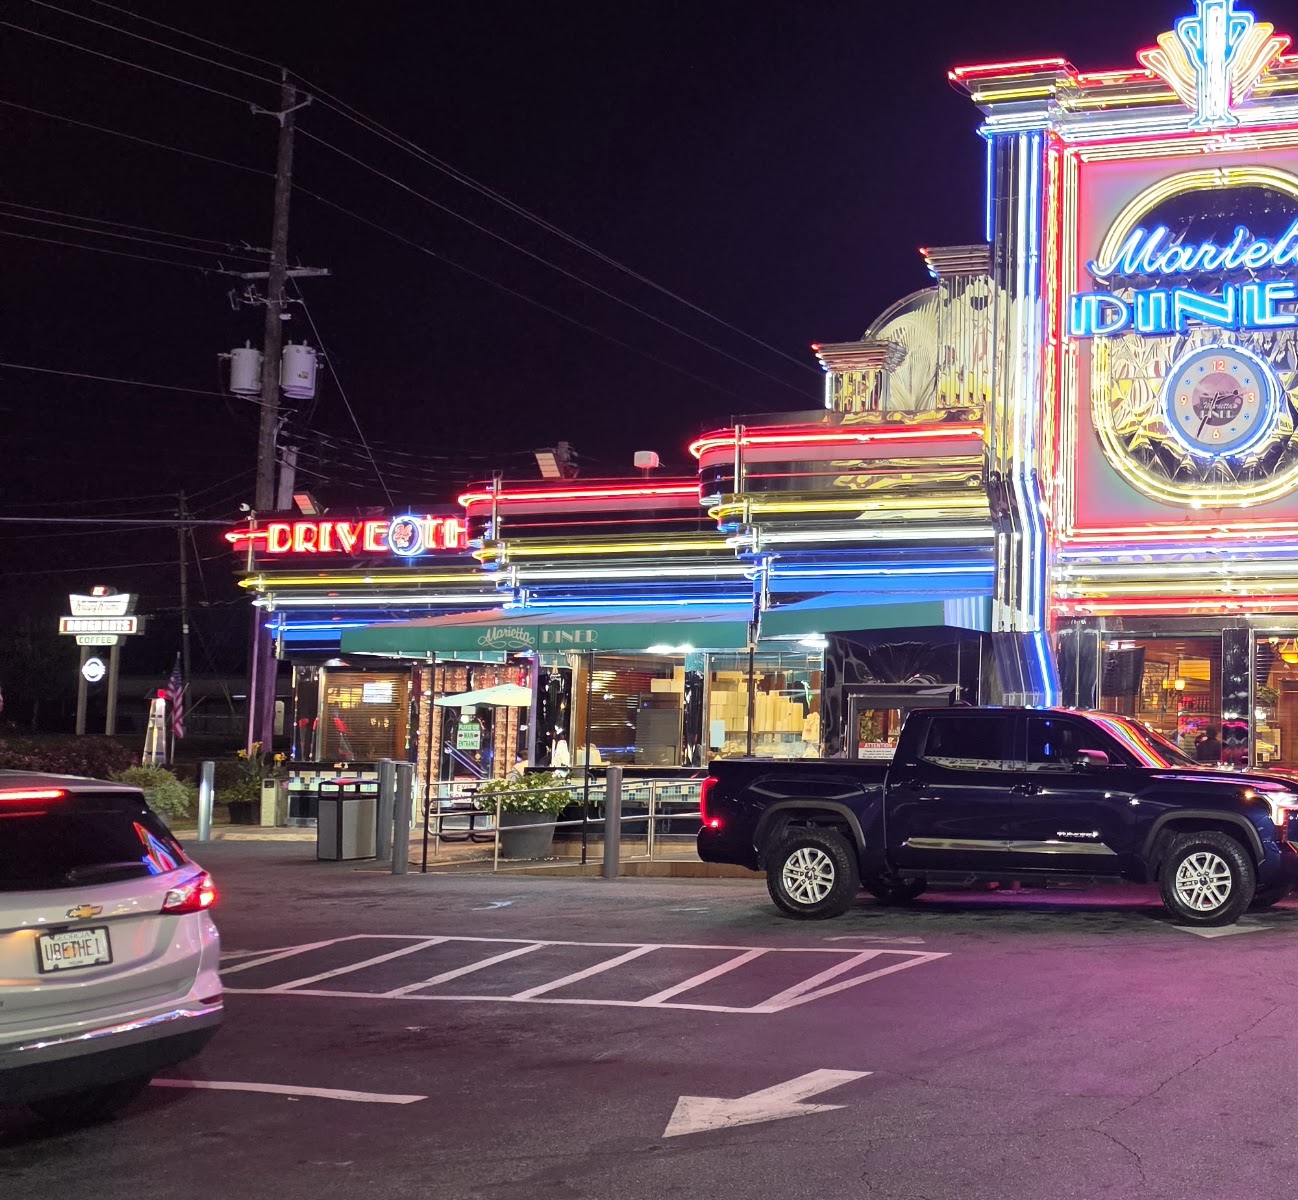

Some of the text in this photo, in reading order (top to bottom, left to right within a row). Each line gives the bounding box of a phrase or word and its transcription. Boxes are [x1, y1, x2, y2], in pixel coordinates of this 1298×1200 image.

[1212, 360, 1226, 371] 12
[1180, 395, 1188, 406] 9
[1247, 392, 1255, 403] 3
[1212, 428, 1220, 439] 6
[267, 519, 390, 553] DRIVE
[78, 636, 112, 644] COFFEE
[478, 626, 598, 648] Marietta DINER
[458, 740, 479, 748] ENTRANCE
